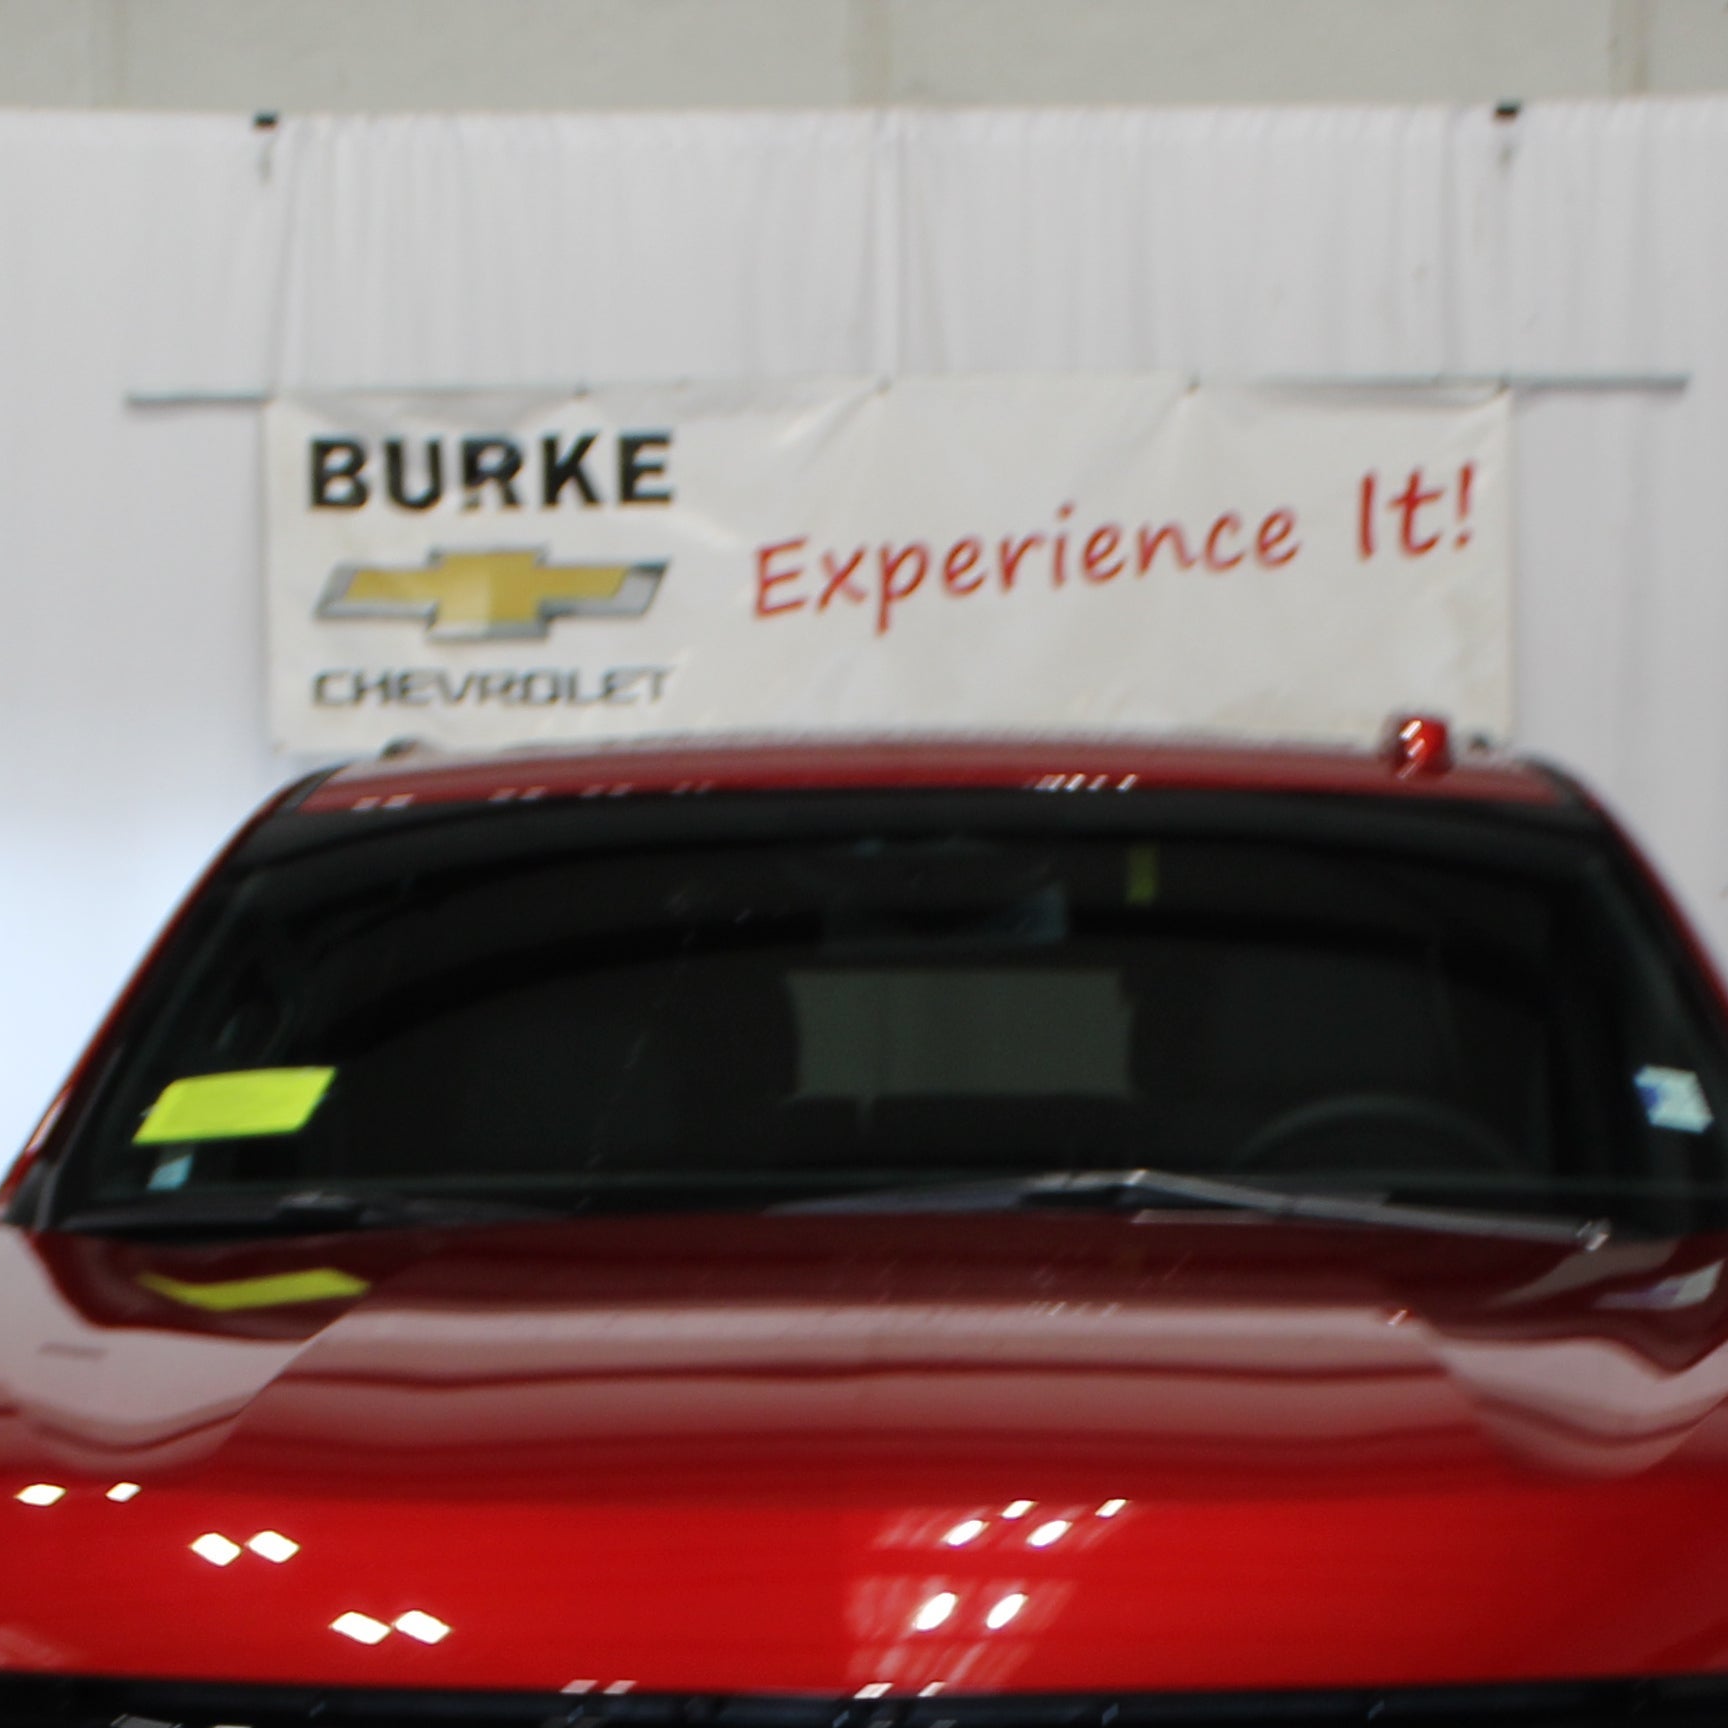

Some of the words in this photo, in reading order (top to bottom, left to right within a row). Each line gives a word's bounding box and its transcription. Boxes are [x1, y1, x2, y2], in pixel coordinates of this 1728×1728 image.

[308, 430, 675, 516] BURKE
[756, 506, 1299, 634] Experience
[1359, 464, 1475, 559] It!
[313, 667, 671, 707] CHEVROLET
